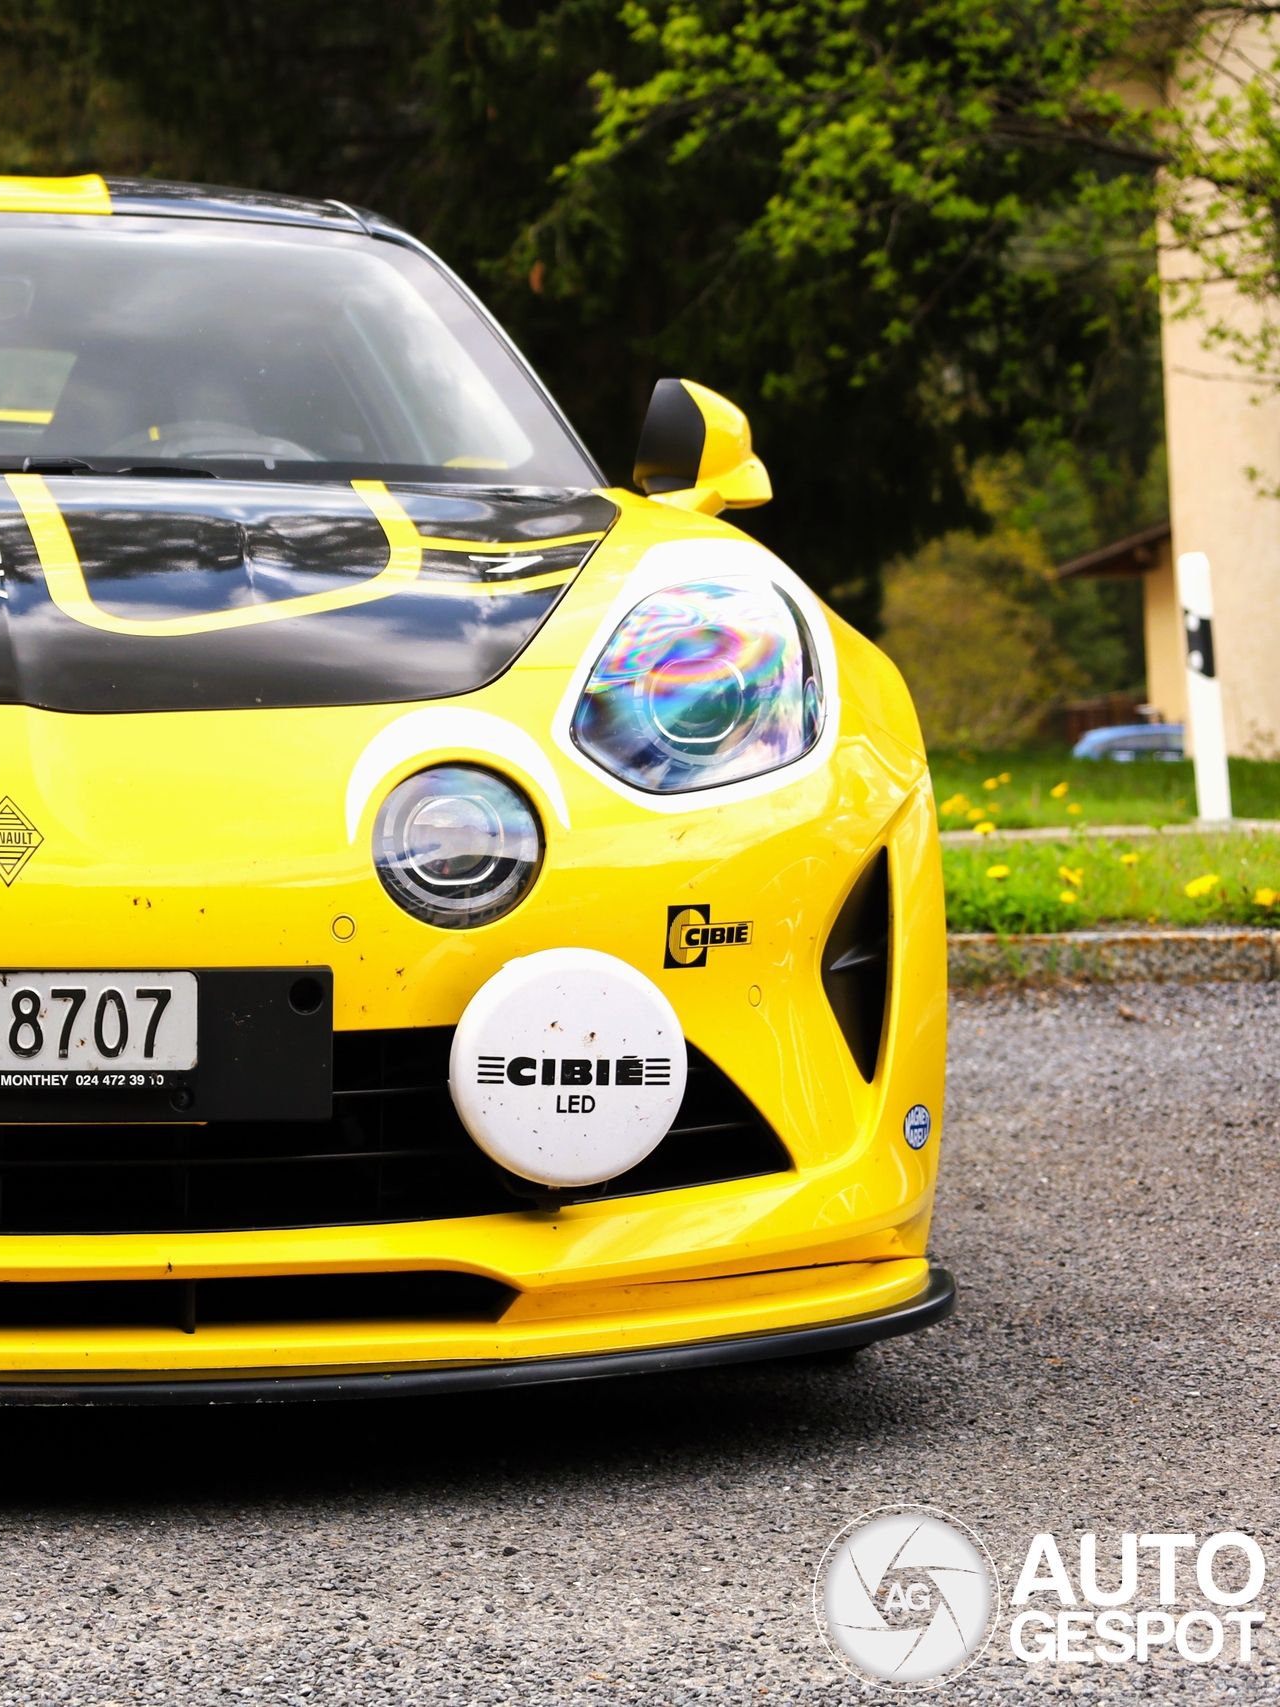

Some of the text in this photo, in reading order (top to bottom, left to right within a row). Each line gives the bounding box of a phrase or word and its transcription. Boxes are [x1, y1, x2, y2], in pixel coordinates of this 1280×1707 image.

[685, 923, 749, 946] CIBIÉ
[0, 1074, 69, 1086] MONTHEY
[75, 1074, 99, 1086] 024
[102, 1074, 126, 1086] 472
[129, 1074, 146, 1086] 39
[148, 1074, 164, 1086] 10
[506, 1055, 644, 1086] CIBIÉ
[556, 1095, 596, 1113] LED
